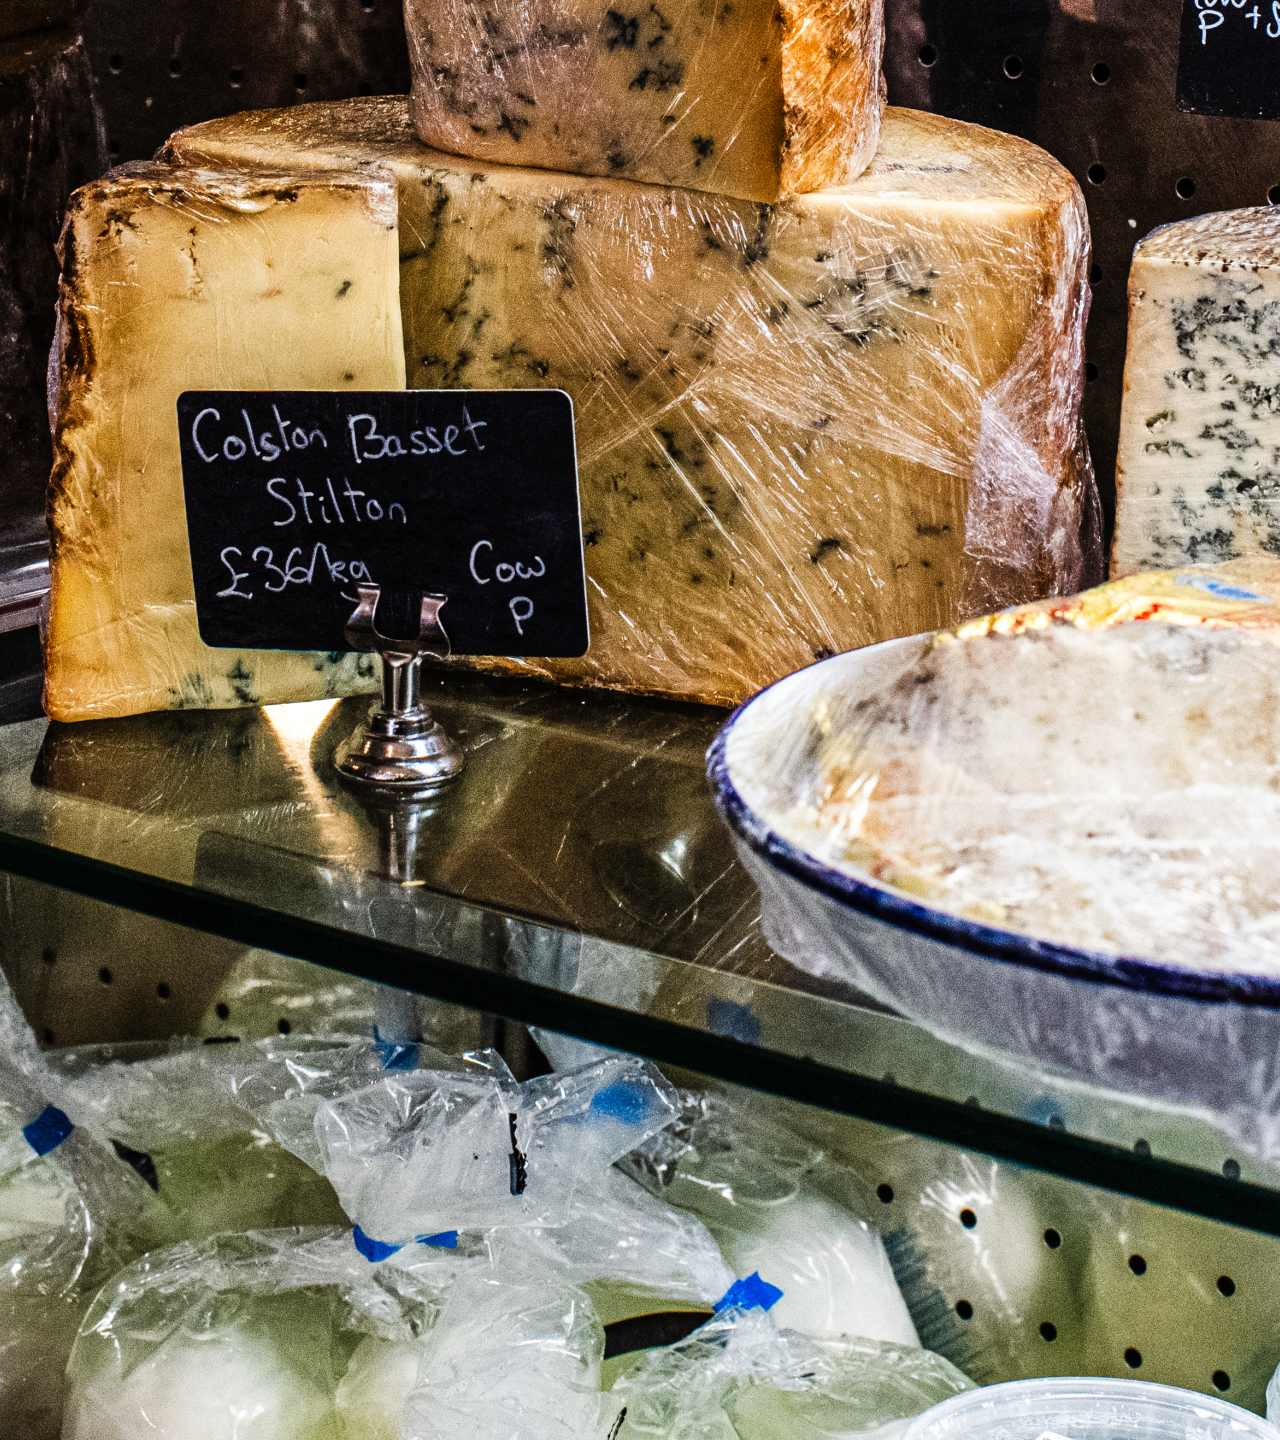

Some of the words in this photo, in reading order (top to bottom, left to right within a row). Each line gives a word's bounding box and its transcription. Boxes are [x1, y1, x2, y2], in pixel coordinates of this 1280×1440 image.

[191, 404, 328, 462] Colston
[346, 403, 488, 463] Basset
[266, 476, 408, 526] Stilton
[469, 539, 547, 585] Cow
